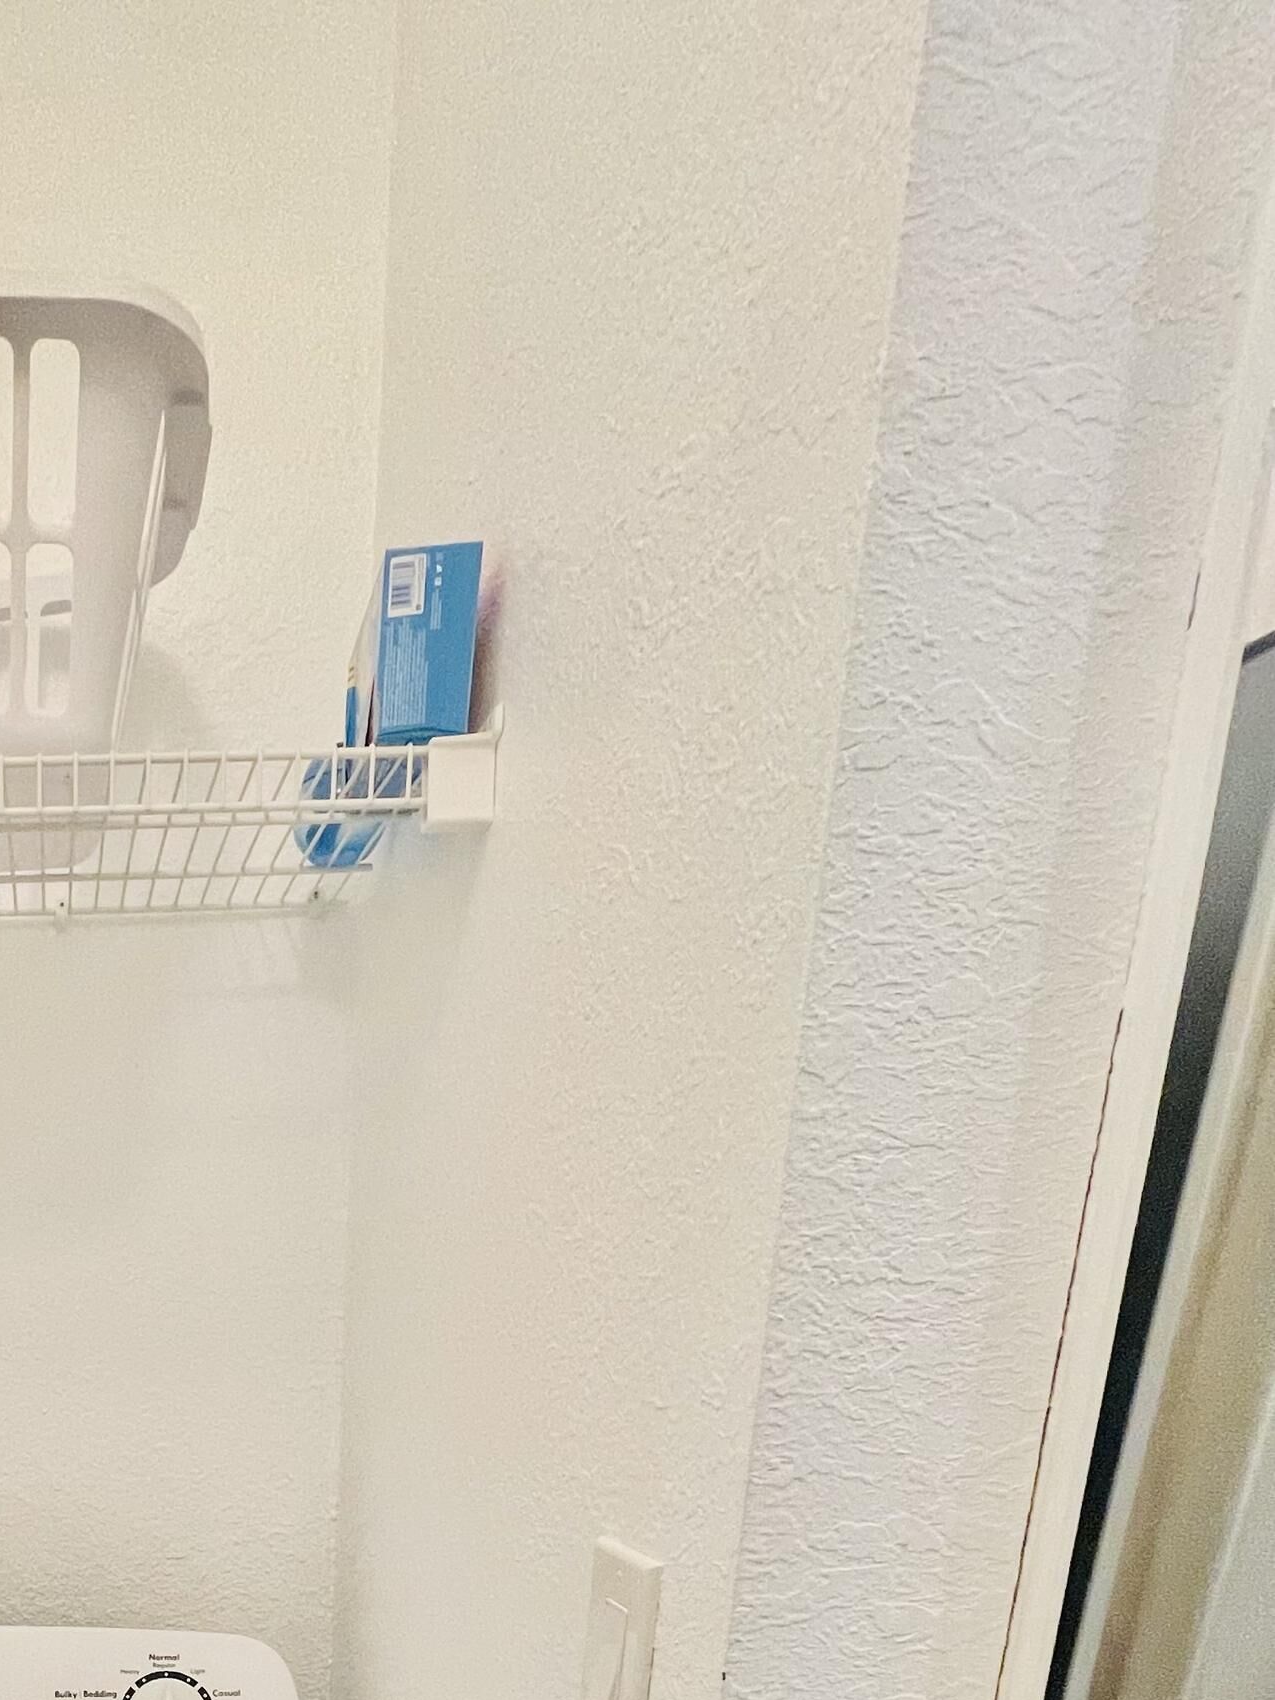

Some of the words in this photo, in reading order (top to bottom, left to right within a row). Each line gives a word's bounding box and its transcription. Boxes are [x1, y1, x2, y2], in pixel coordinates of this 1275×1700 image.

[54, 1690, 77, 1699] Bulky
[83, 1690, 117, 1699] Bedding
[212, 1689, 241, 1697] Casual
